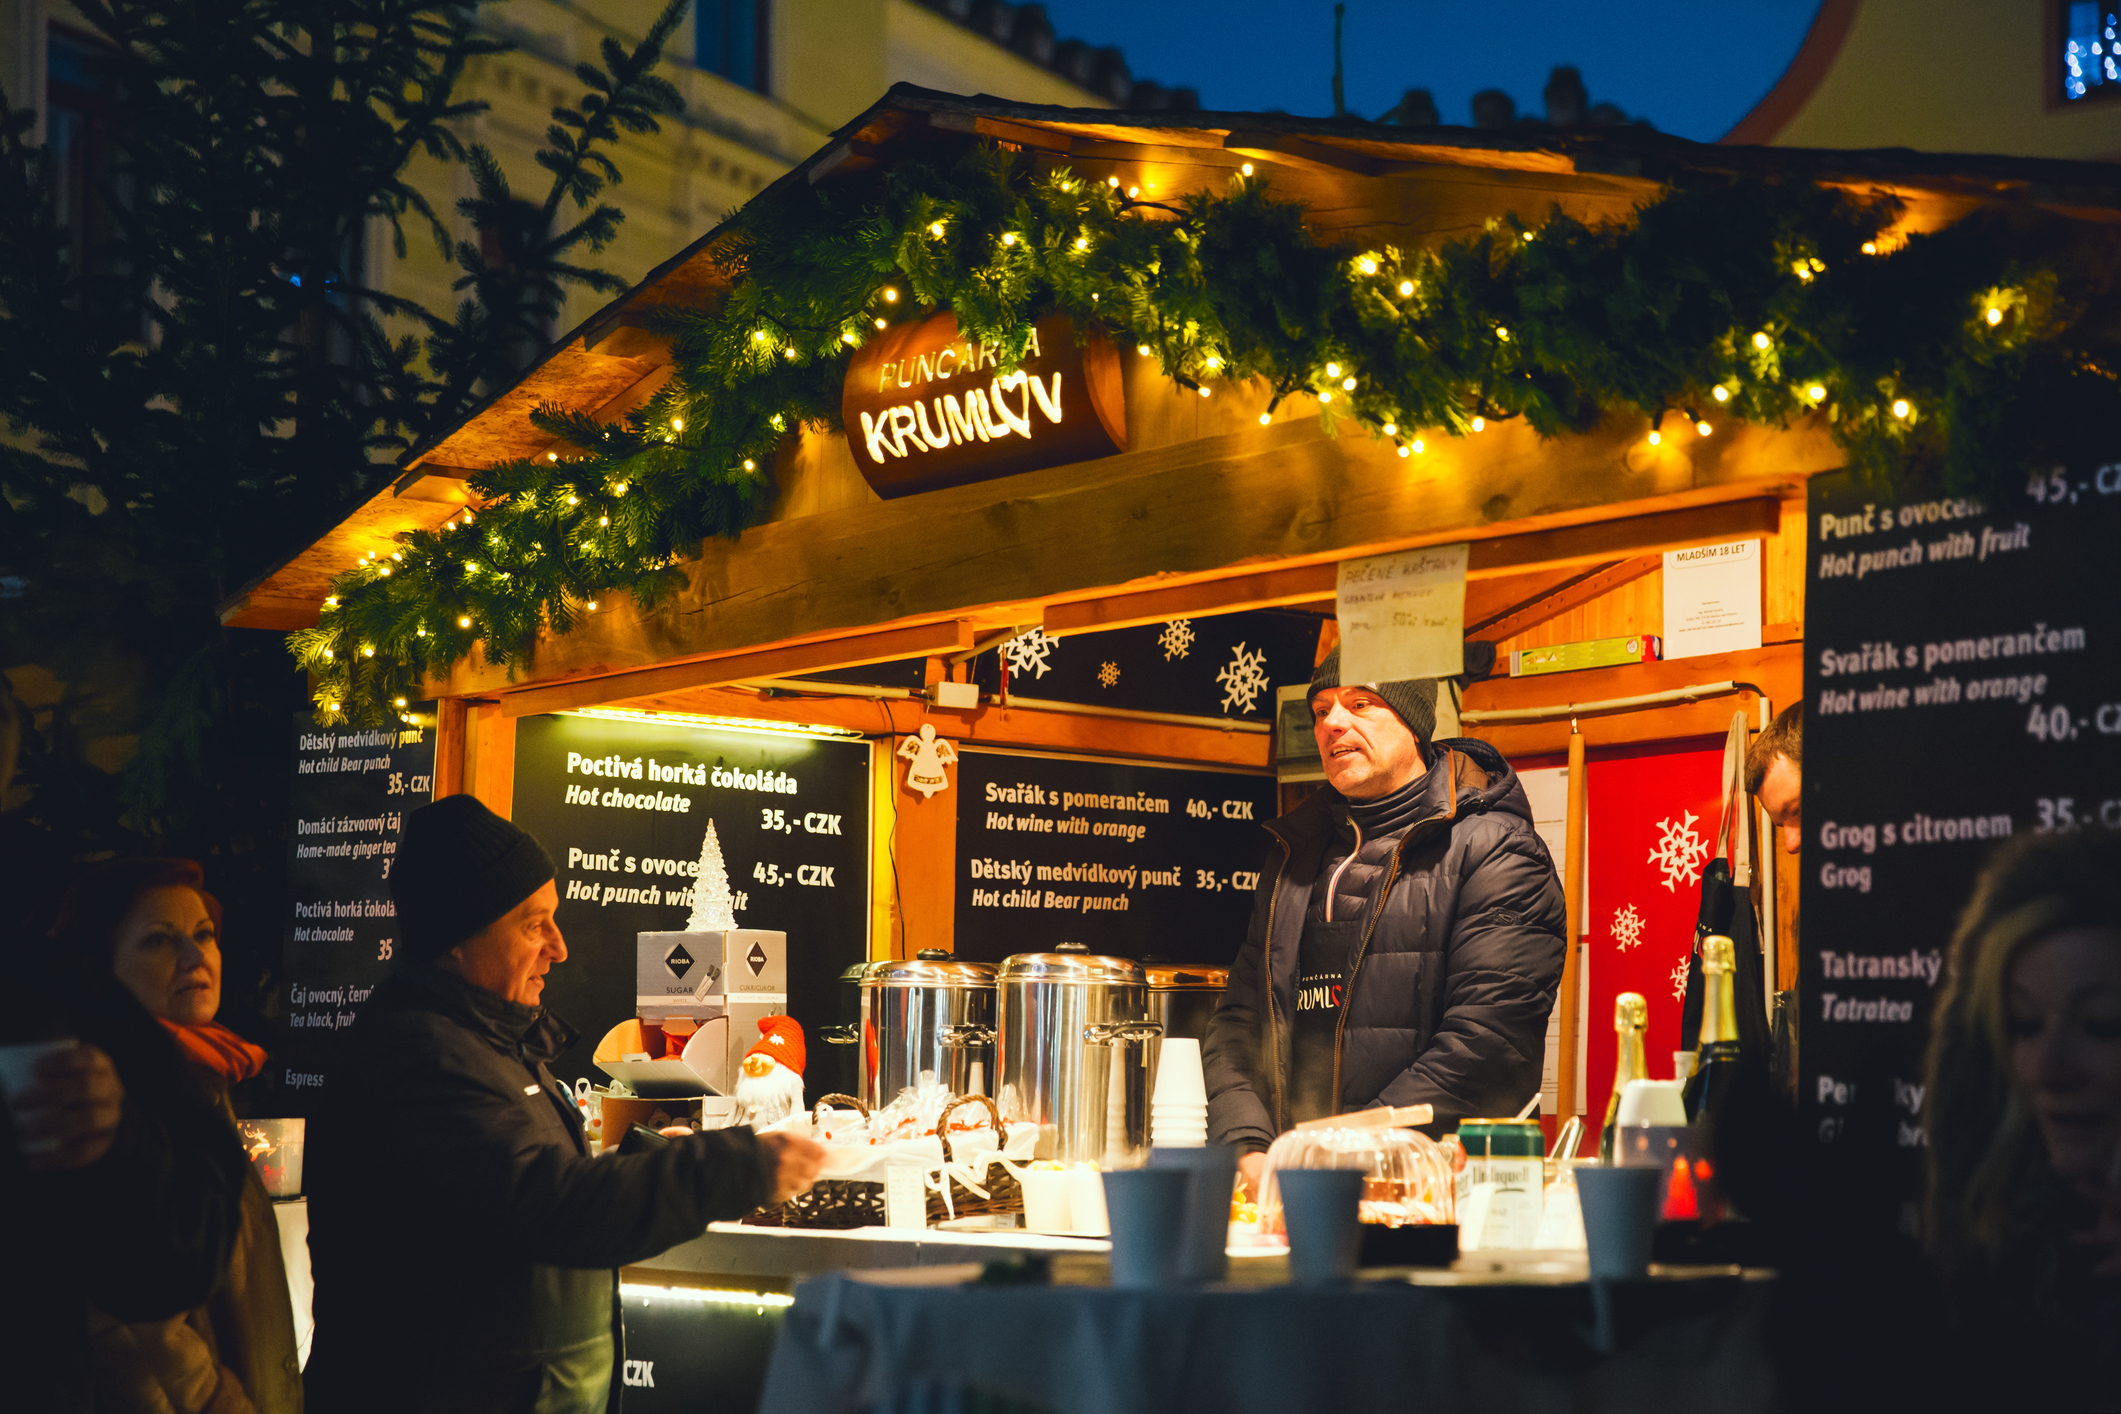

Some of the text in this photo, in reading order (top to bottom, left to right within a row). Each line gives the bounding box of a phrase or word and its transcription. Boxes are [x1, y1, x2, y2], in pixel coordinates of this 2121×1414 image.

[1819, 504, 1876, 541] Punč
[1880, 509, 1893, 530] s
[1677, 544, 1745, 562] MLADŠÍM 18 LET
[1818, 523, 2030, 581] Hot punch with fruit
[1820, 623, 2085, 677] Svařák s pomerančem
[1818, 673, 2048, 715] Hot wine with orange
[300, 727, 423, 753] Dětský medvídkový punč
[298, 754, 391, 774] Hot child Bear punch
[567, 752, 798, 795] Poctivá horká čokoláda
[387, 772, 430, 795] 35,- CZK
[565, 785, 691, 813] Hot chocolate
[986, 782, 1254, 821] Svařák s pomerančem 40,- CZK
[298, 812, 401, 835] Domácí zázvorový čaj
[761, 809, 842, 835] 35,- CZK
[986, 812, 1146, 842] Hot wine with orange
[1820, 820, 1877, 854] Grog
[1882, 826, 1897, 846] s
[1902, 813, 2013, 845] citronem
[297, 840, 396, 860] Home-made ginger tea
[381, 858, 395, 879] 3
[568, 847, 835, 887] Punč s ovoce 45,- CZK
[971, 858, 1032, 886] Dětský
[1037, 863, 1138, 889] medvídkový
[1141, 867, 1182, 890] punč
[1196, 869, 1228, 892] 35,-
[1819, 861, 1872, 893] Grog
[566, 880, 599, 901] Hot
[602, 881, 661, 906] punch
[666, 888, 694, 908] wit
[972, 889, 1129, 914] Hot child Bear punch
[295, 900, 397, 917] Poctivá horká čokolá
[294, 927, 354, 942] Hot chocolate
[378, 938, 392, 961] 35
[1820, 948, 1944, 987] Tatranský
[291, 983, 374, 1007] Čaj ovocný, čern
[1820, 992, 1913, 1023] Tatratea
[290, 1013, 304, 1027] Tea
[307, 1012, 334, 1029] black,
[623, 1360, 655, 1388] CZK
